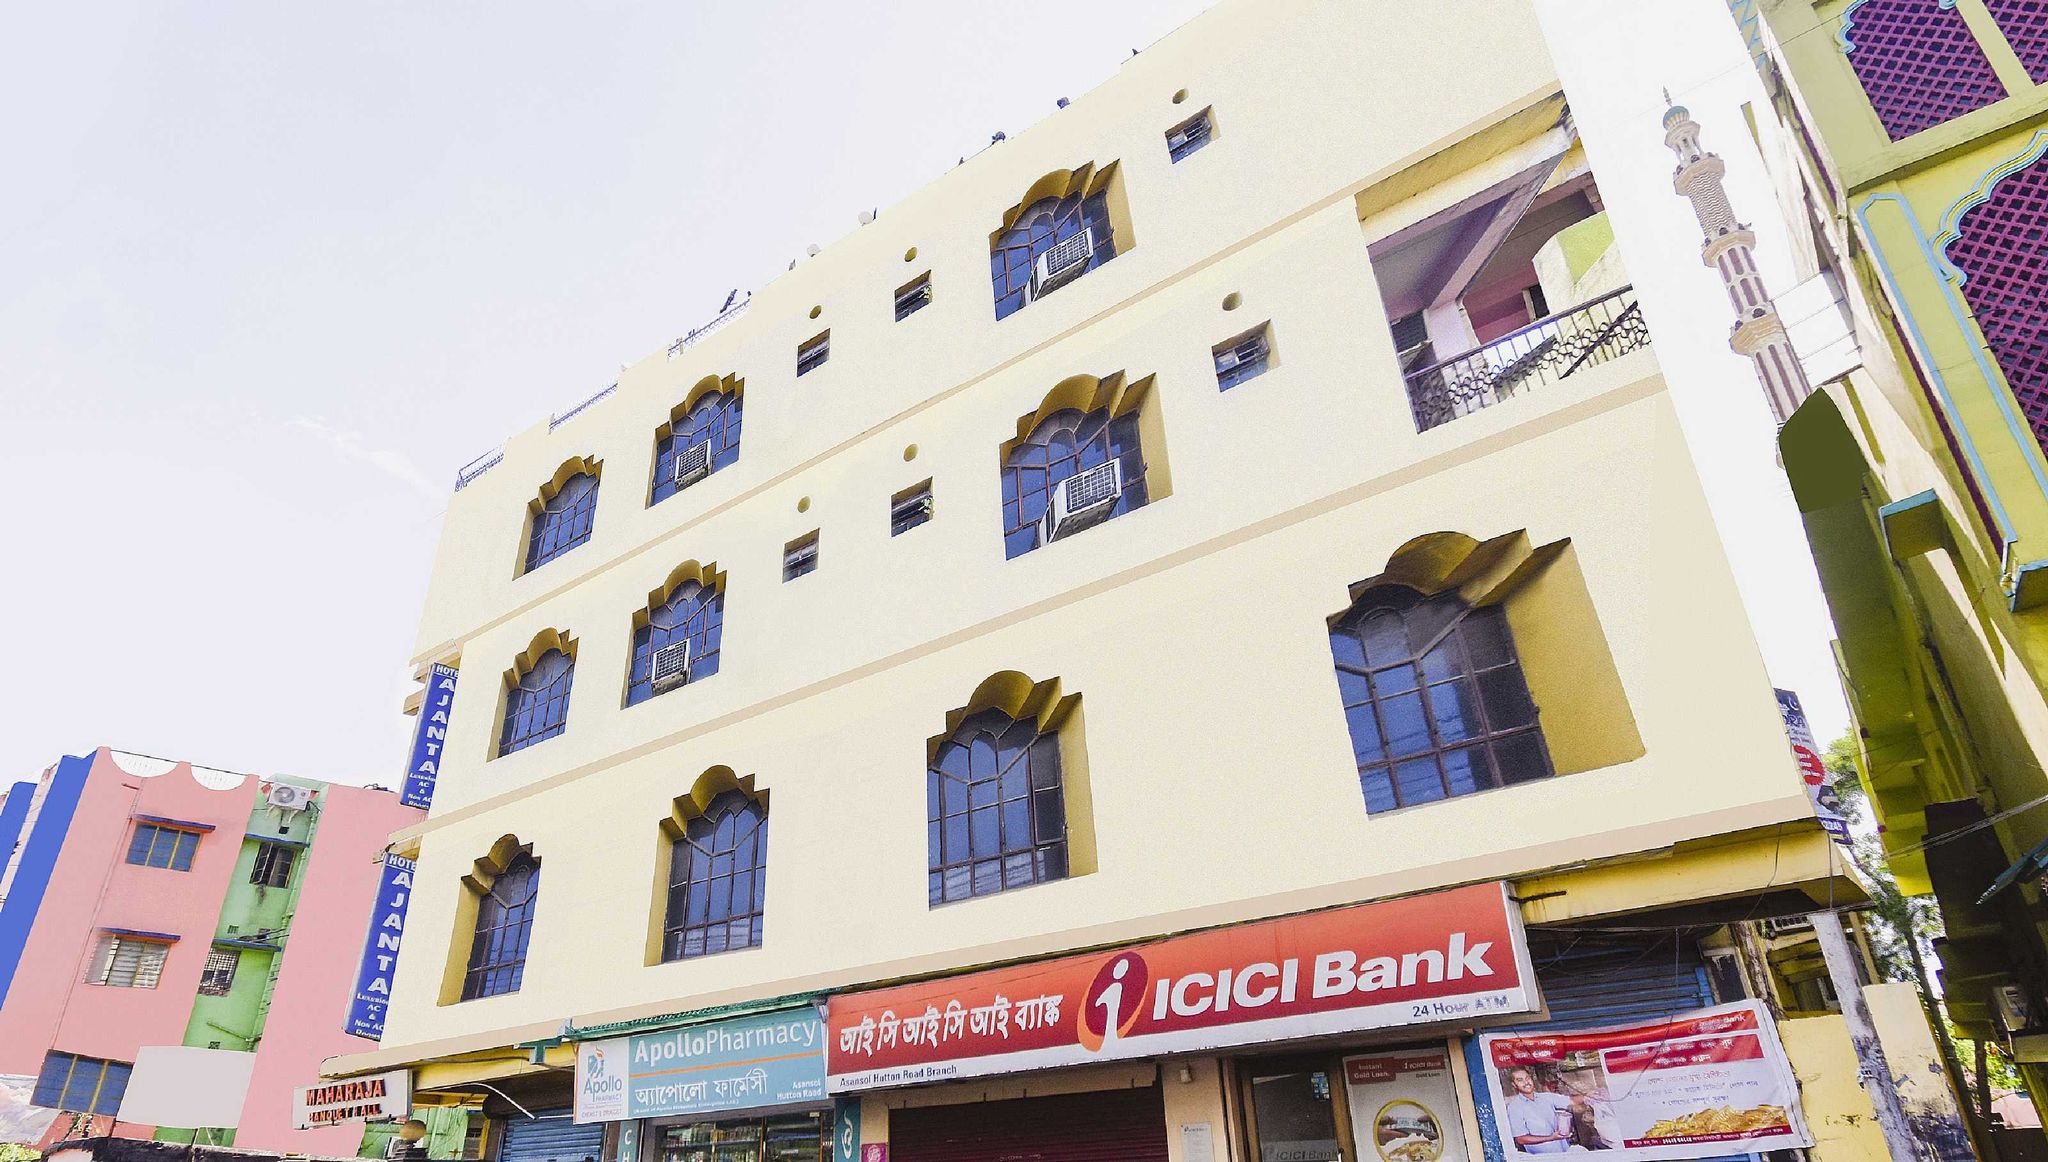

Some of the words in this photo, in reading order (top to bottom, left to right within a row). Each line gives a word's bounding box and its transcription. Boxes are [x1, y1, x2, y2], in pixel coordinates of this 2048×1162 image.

[436, 664, 459, 678] HOTE
[418, 678, 455, 775] AJANTA
[388, 855, 417, 871] HOTE
[368, 872, 412, 995] AJANTA
[1152, 958, 1299, 1021] ICICI
[1312, 932, 1495, 998] Bank
[367, 1004, 382, 1012] AC
[1412, 1003, 1430, 1018] 24
[1433, 1001, 1470, 1016] Hour
[1475, 994, 1510, 1011] ATM
[877, 1010, 901, 1050] সি
[943, 999, 967, 1042] সি
[792, 1079, 821, 1090] Asansol
[839, 1074, 871, 1087] Asansol
[873, 1072, 901, 1083] Hutton
[903, 1069, 924, 1079] Road
[926, 1065, 957, 1077] Branch
[306, 1078, 386, 1106] MAHARAJA
[583, 1075, 623, 1102] Apollo
[776, 1091, 802, 1101] Hutton
[803, 1088, 822, 1098] Road
